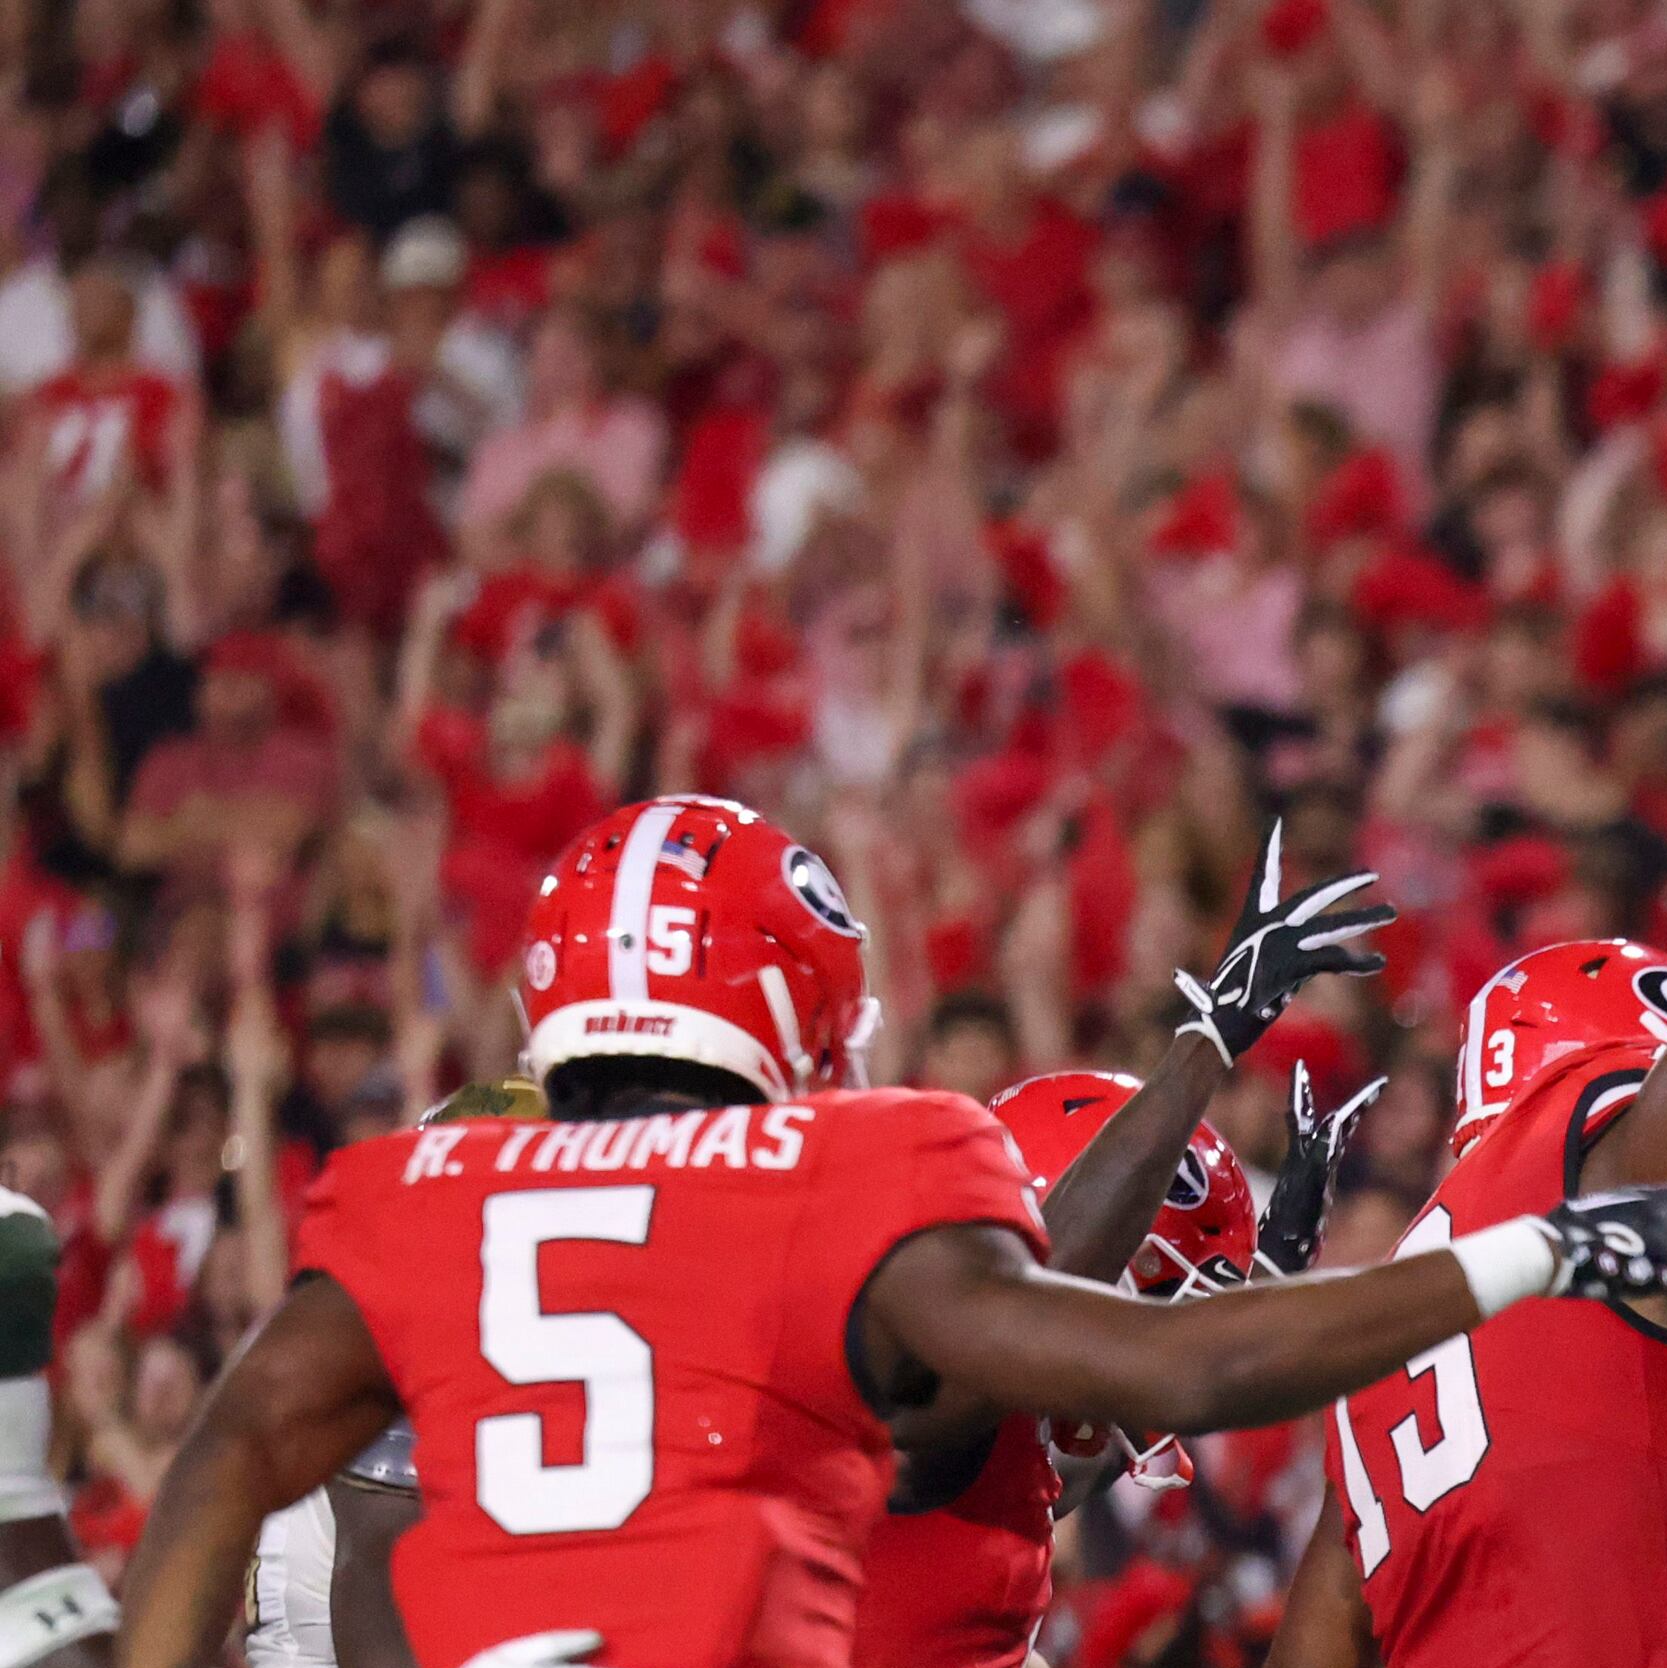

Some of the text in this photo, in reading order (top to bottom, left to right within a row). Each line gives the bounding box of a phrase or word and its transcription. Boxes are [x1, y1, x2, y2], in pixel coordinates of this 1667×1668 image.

[647, 905, 697, 976] 5
[1486, 1029, 1516, 1087] 3
[403, 1105, 816, 1186] R. THOMAS
[475, 1184, 657, 1535] 5
